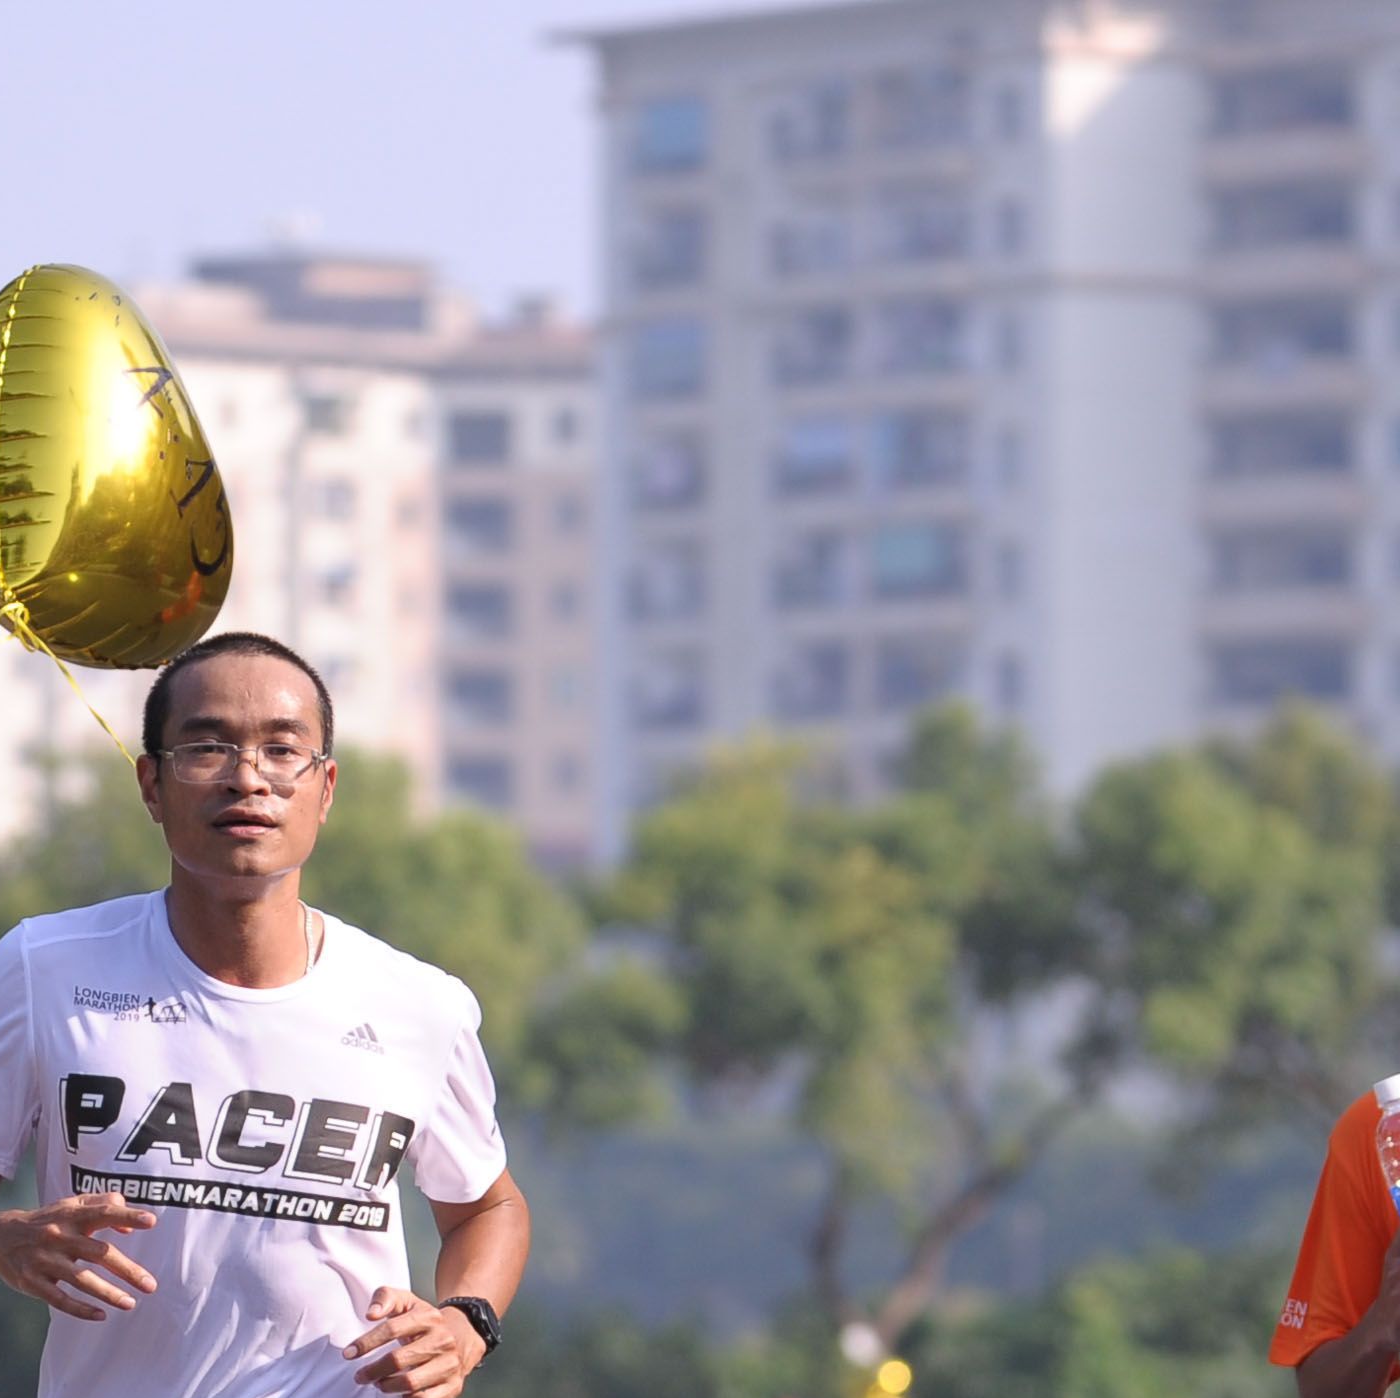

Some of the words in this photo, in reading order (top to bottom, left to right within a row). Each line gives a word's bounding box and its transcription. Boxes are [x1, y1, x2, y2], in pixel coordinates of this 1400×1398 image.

[74, 985, 140, 1004] LONGBIEN
[73, 997, 140, 1012] MARATHON
[113, 1011, 140, 1021] 2019
[341, 1036, 384, 1055] adidas
[59, 1073, 415, 1191] PACER
[75, 1172, 333, 1220] LONGBIENMARATHON
